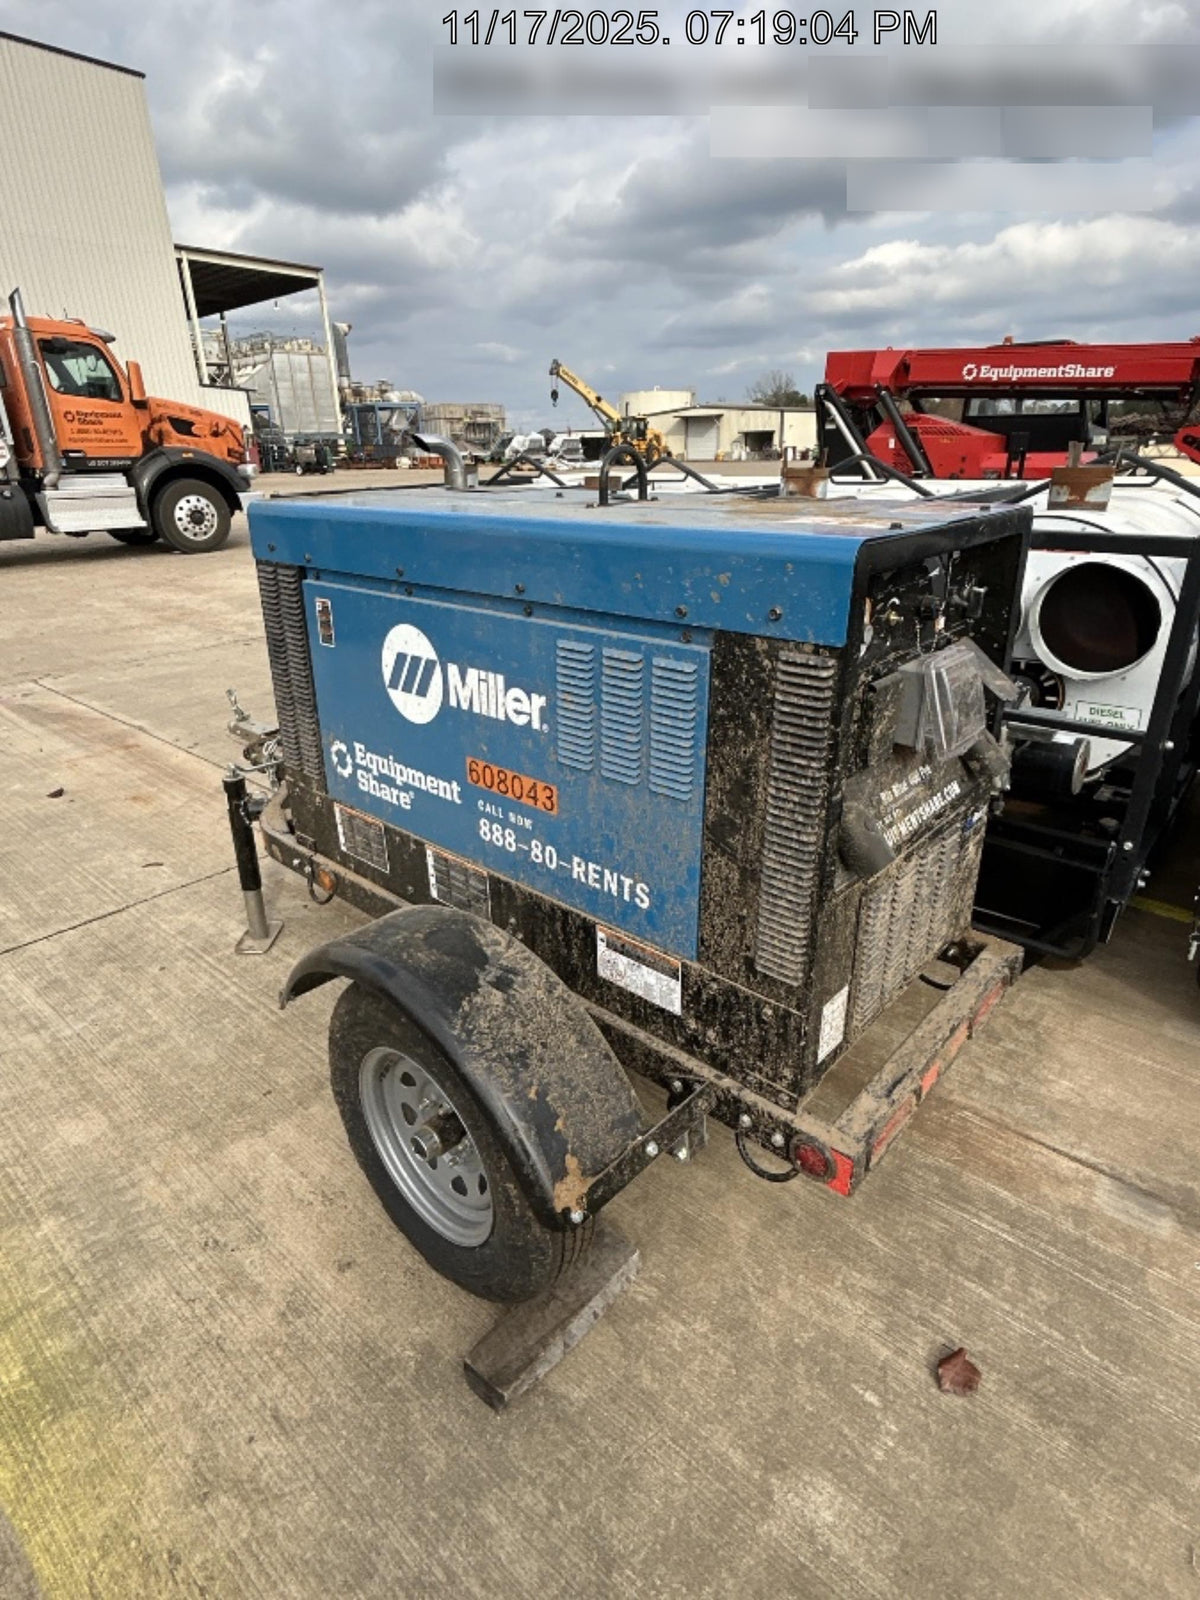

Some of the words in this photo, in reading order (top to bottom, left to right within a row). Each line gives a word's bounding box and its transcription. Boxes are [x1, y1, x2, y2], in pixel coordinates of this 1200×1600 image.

[979, 364, 1115, 381] EquipmentShare
[447, 663, 547, 731] Miller
[1089, 707, 1123, 719] DIESEL
[353, 742, 462, 804] Equipment
[468, 760, 555, 811] 608043
[477, 800, 504, 819] CALL
[479, 818, 650, 909] 888-80-RENTS
